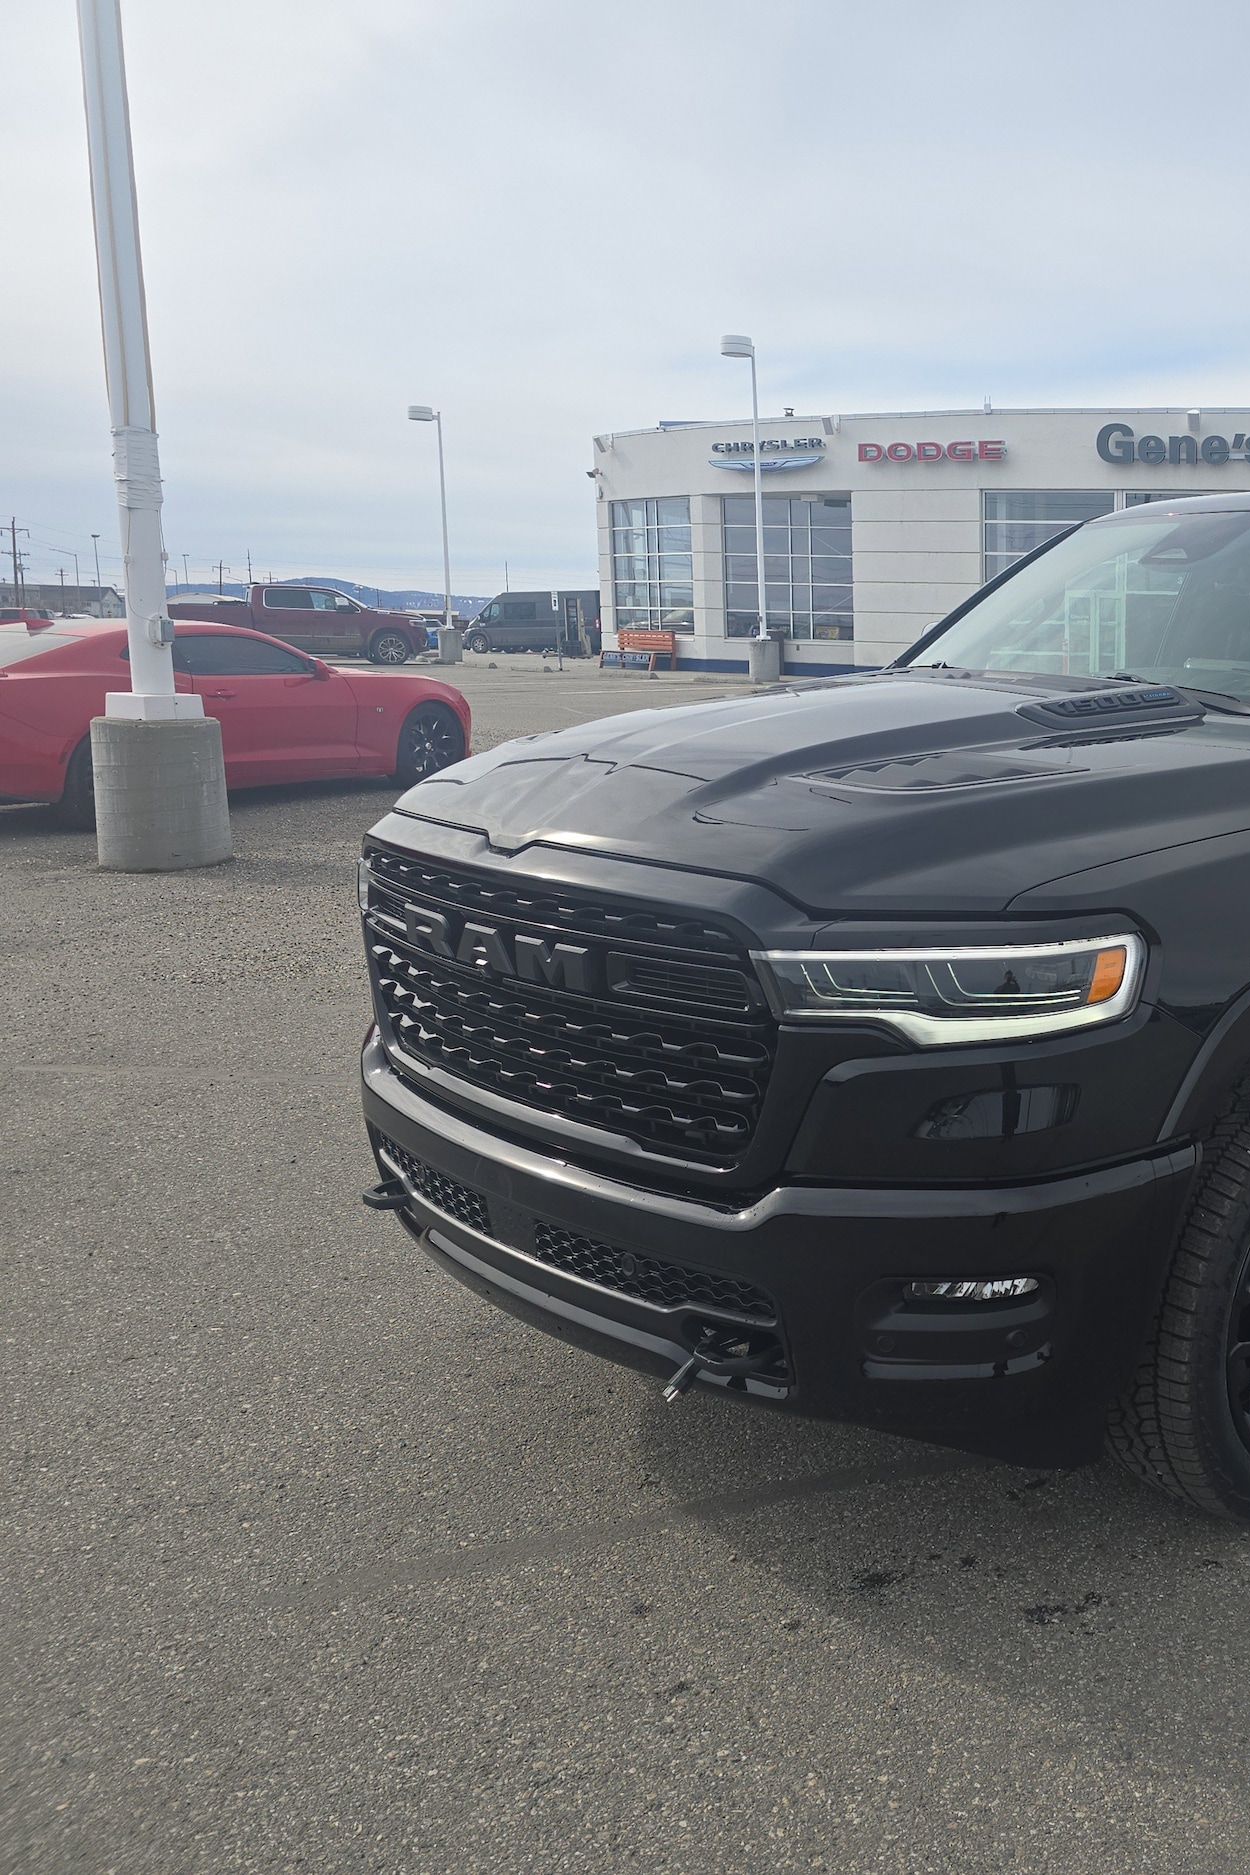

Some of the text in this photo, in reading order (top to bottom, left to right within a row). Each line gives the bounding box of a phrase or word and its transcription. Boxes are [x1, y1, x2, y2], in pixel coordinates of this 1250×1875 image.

[711, 438, 823, 453] CHRYSLER
[857, 440, 1005, 462] DODGE
[1058, 692, 1141, 713] 1500
[404, 902, 591, 992] RAM
